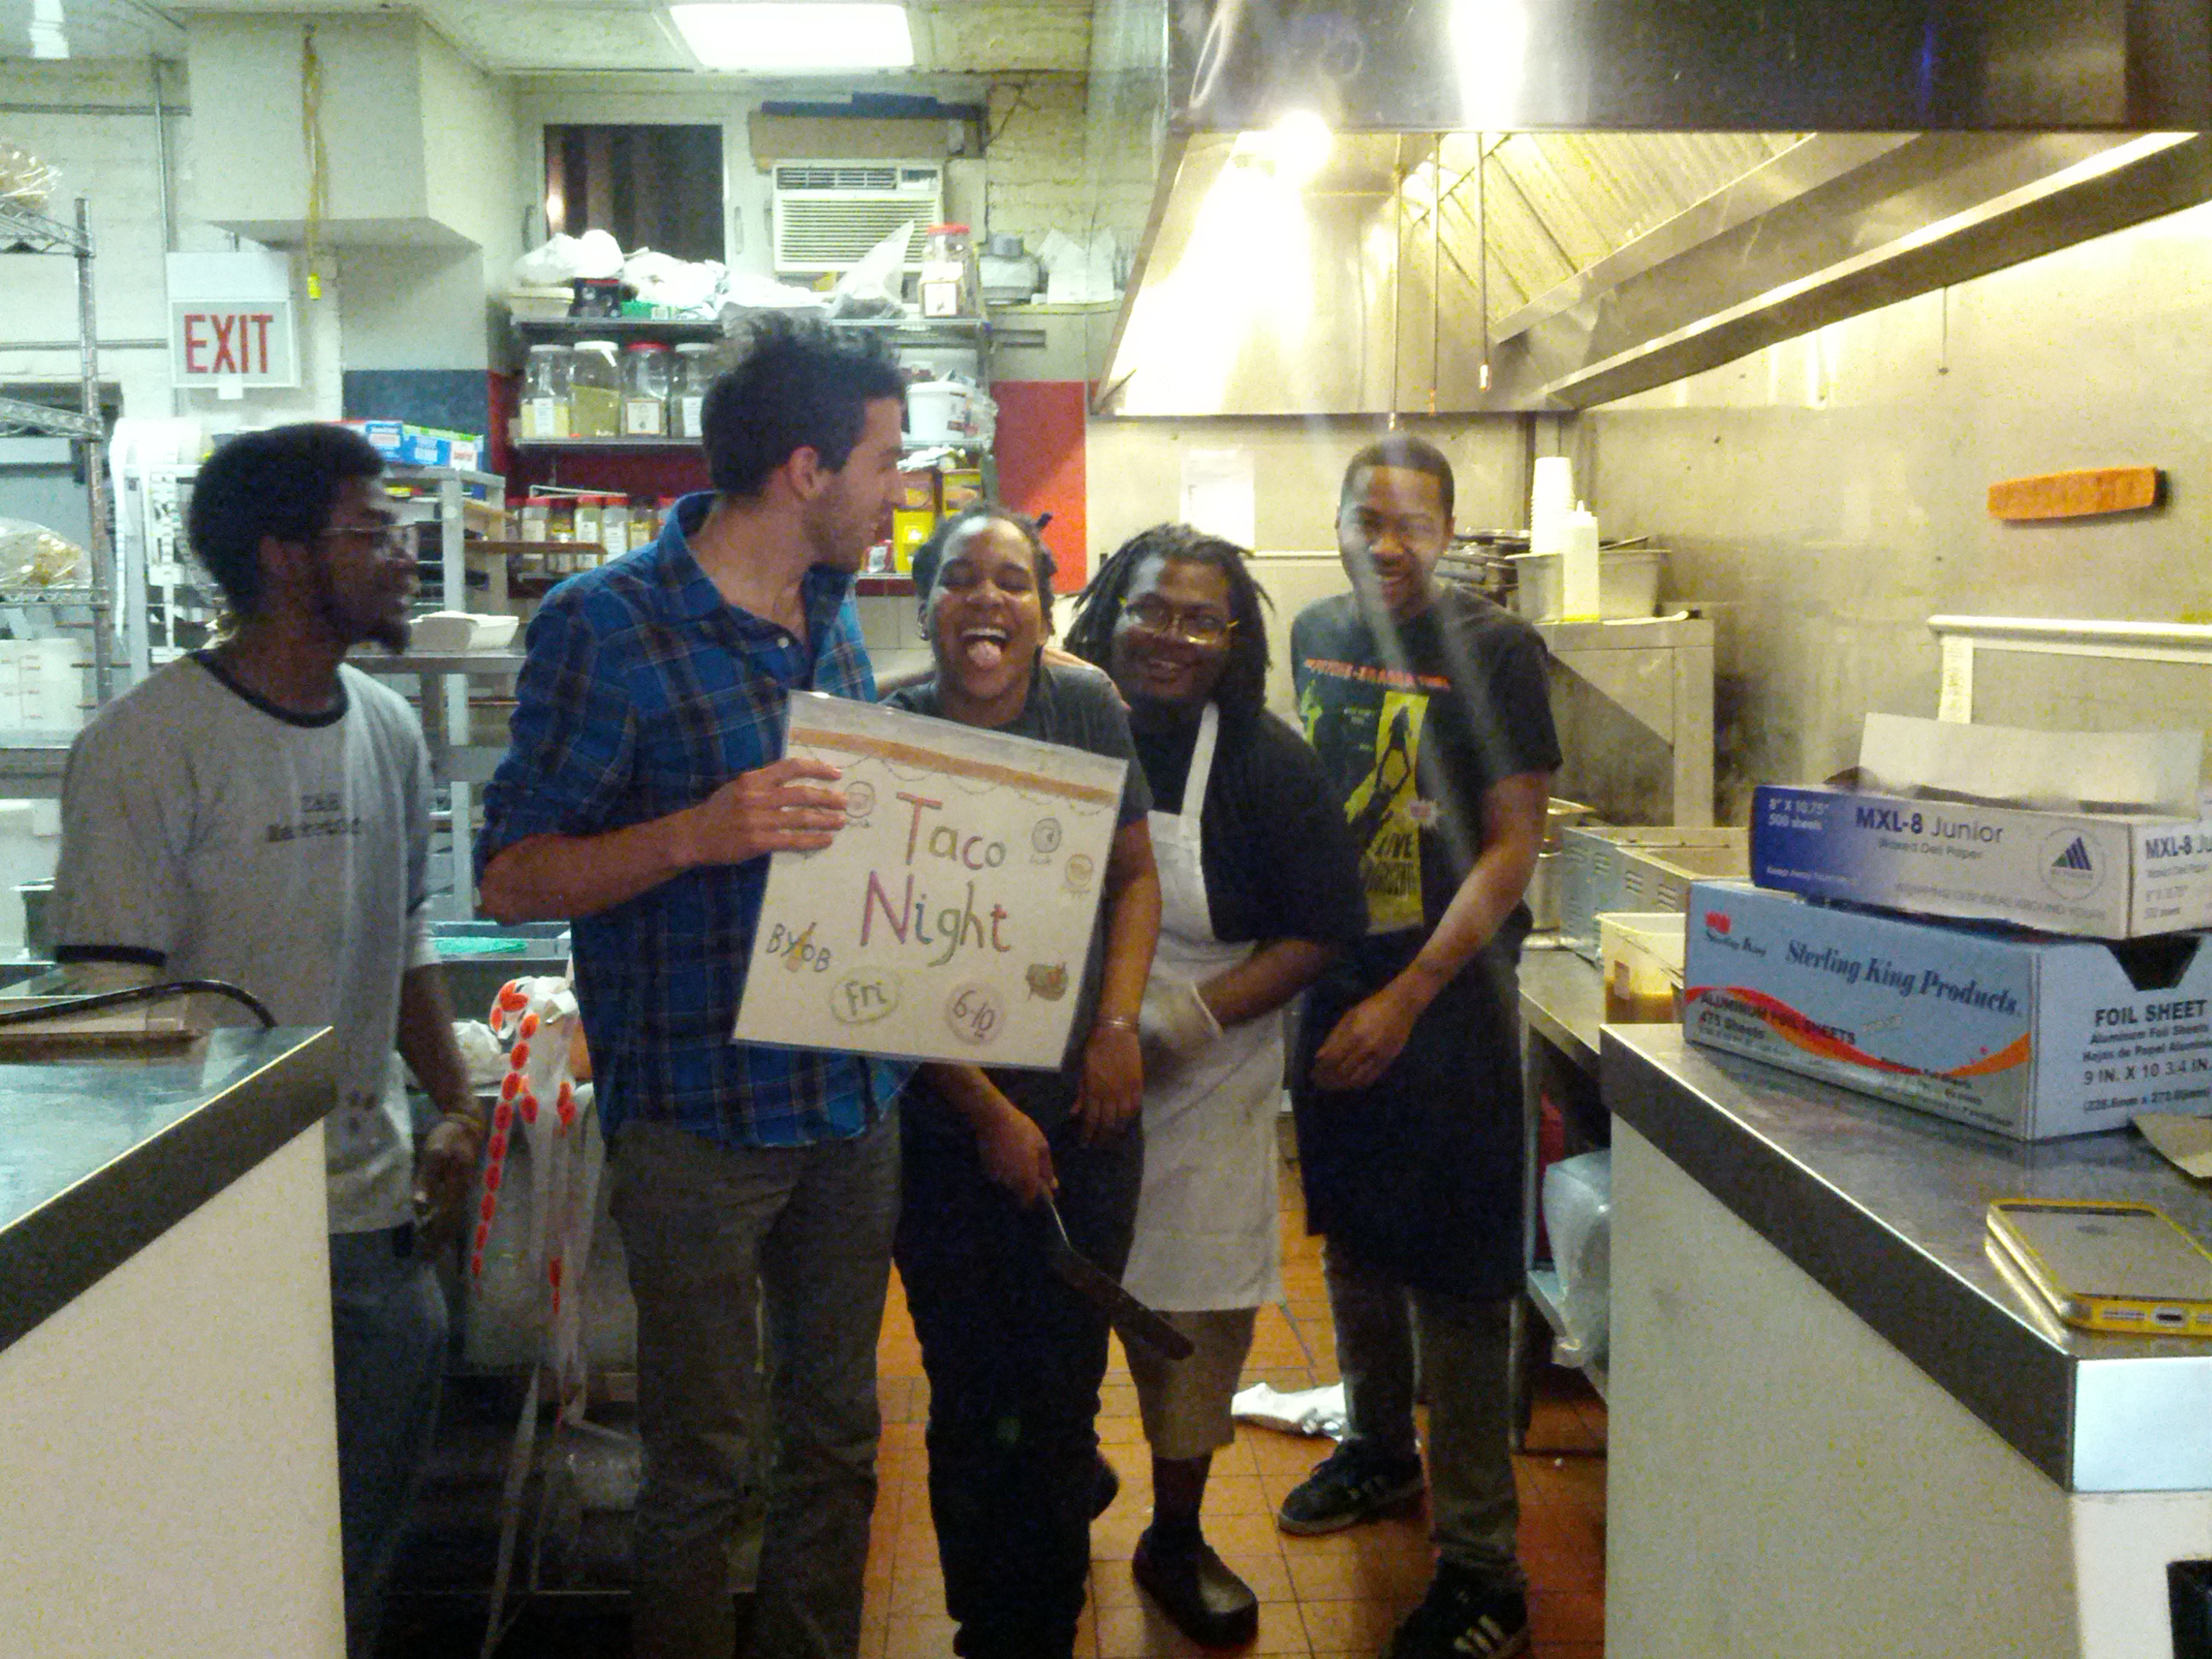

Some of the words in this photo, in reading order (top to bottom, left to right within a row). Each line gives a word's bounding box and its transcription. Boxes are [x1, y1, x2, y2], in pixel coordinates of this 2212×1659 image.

[184, 313, 273, 373] EXIT
[896, 792, 1006, 870] Taco
[1856, 806, 1923, 834] MXL-8
[1930, 816, 2003, 843] Junior
[2145, 835, 2192, 859] MXL-8
[860, 870, 1012, 967] Night
[765, 923, 832, 973] BYOB
[1785, 939, 1862, 984] Sterling
[1865, 957, 1916, 997] King
[844, 981, 888, 1016] Fri
[2095, 1005, 2139, 1027] FOIL
[2145, 998, 2209, 1022] SHEET
[2083, 1070, 2093, 1086] 9
[2125, 1065, 2136, 1081] X
[2143, 1062, 2161, 1078] 10
